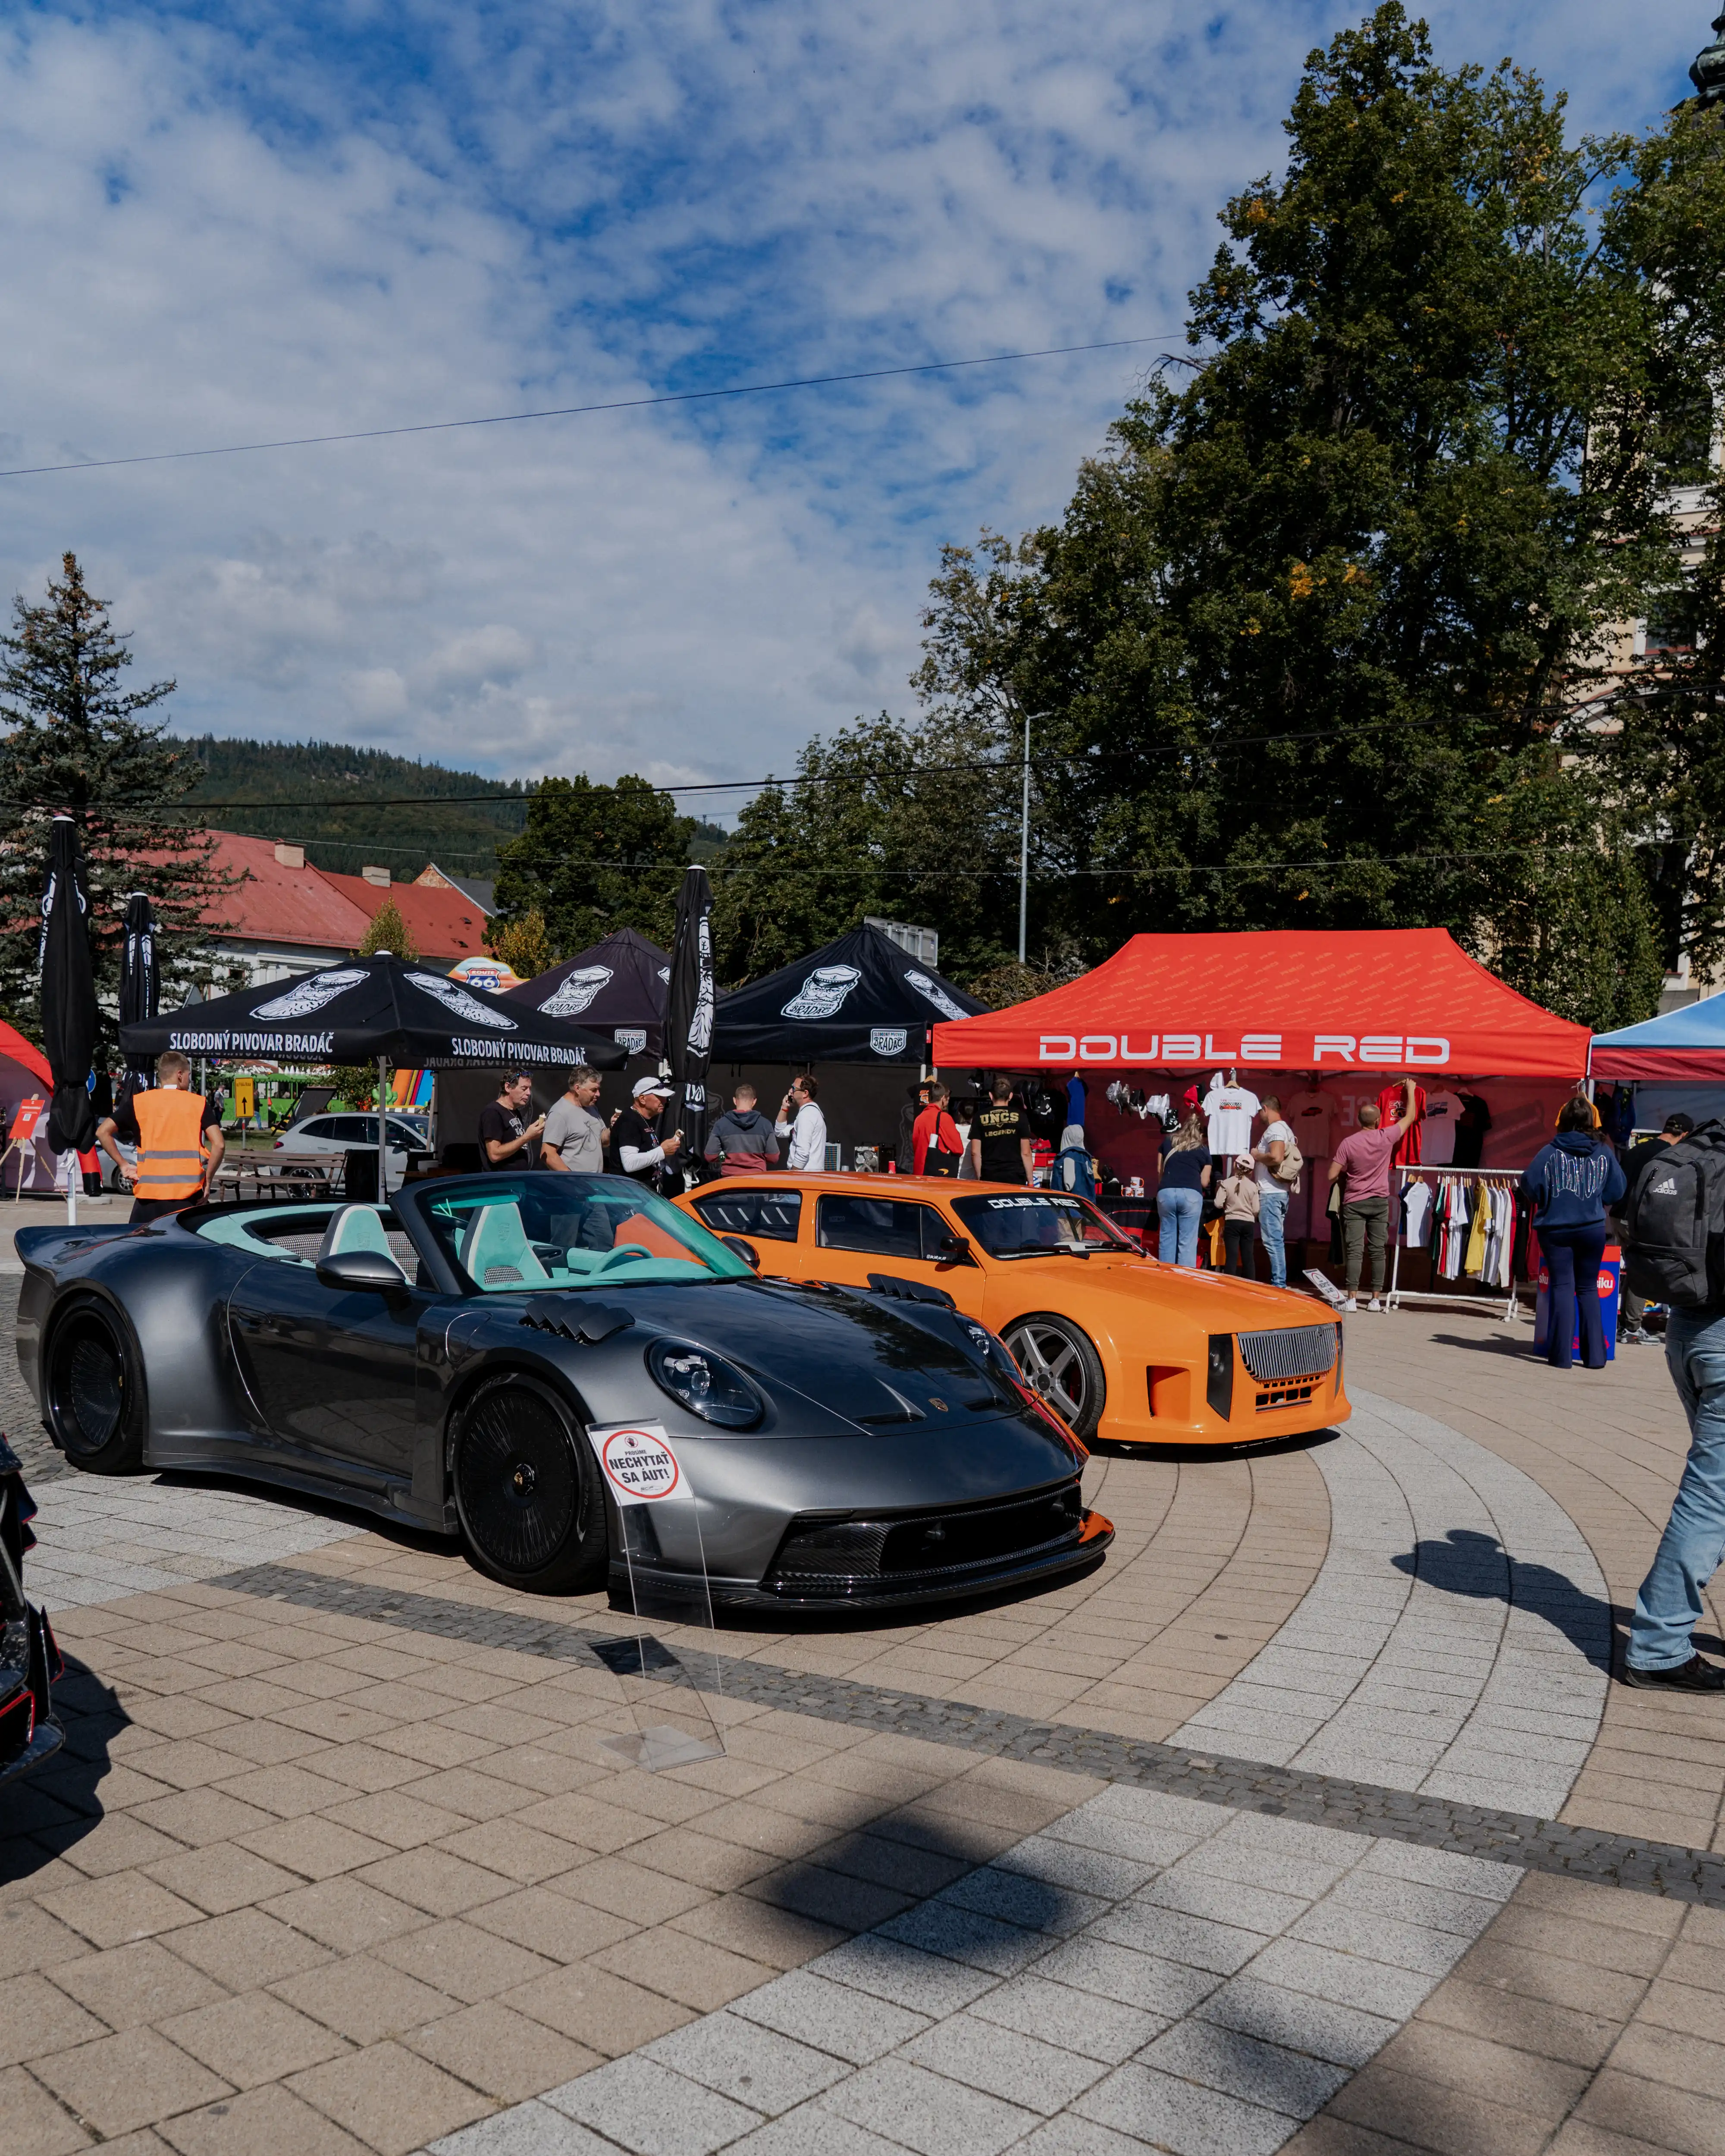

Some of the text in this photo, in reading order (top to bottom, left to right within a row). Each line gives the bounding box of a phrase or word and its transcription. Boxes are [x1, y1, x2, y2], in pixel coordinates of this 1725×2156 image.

[470, 977, 495, 988] 66
[170, 1030, 334, 1053] SLOBODNÝ PIVOVAR BRADÁČ
[452, 1038, 506, 1058] SLOBODNÝ
[508, 1042, 550, 1062] PIVOVAR
[550, 1047, 587, 1065] BRADÁČ
[1039, 1034, 1450, 1065] DOUBLE RED
[980, 1112, 1019, 1124] UNCS
[985, 1129, 1016, 1137] LEGENDY
[988, 1198, 1080, 1209] DOUBLE RED
[1539, 1273, 1549, 1285] siku
[608, 1451, 669, 1470] NECHYTAŤ
[621, 1468, 670, 1483] SA ÁUT!
